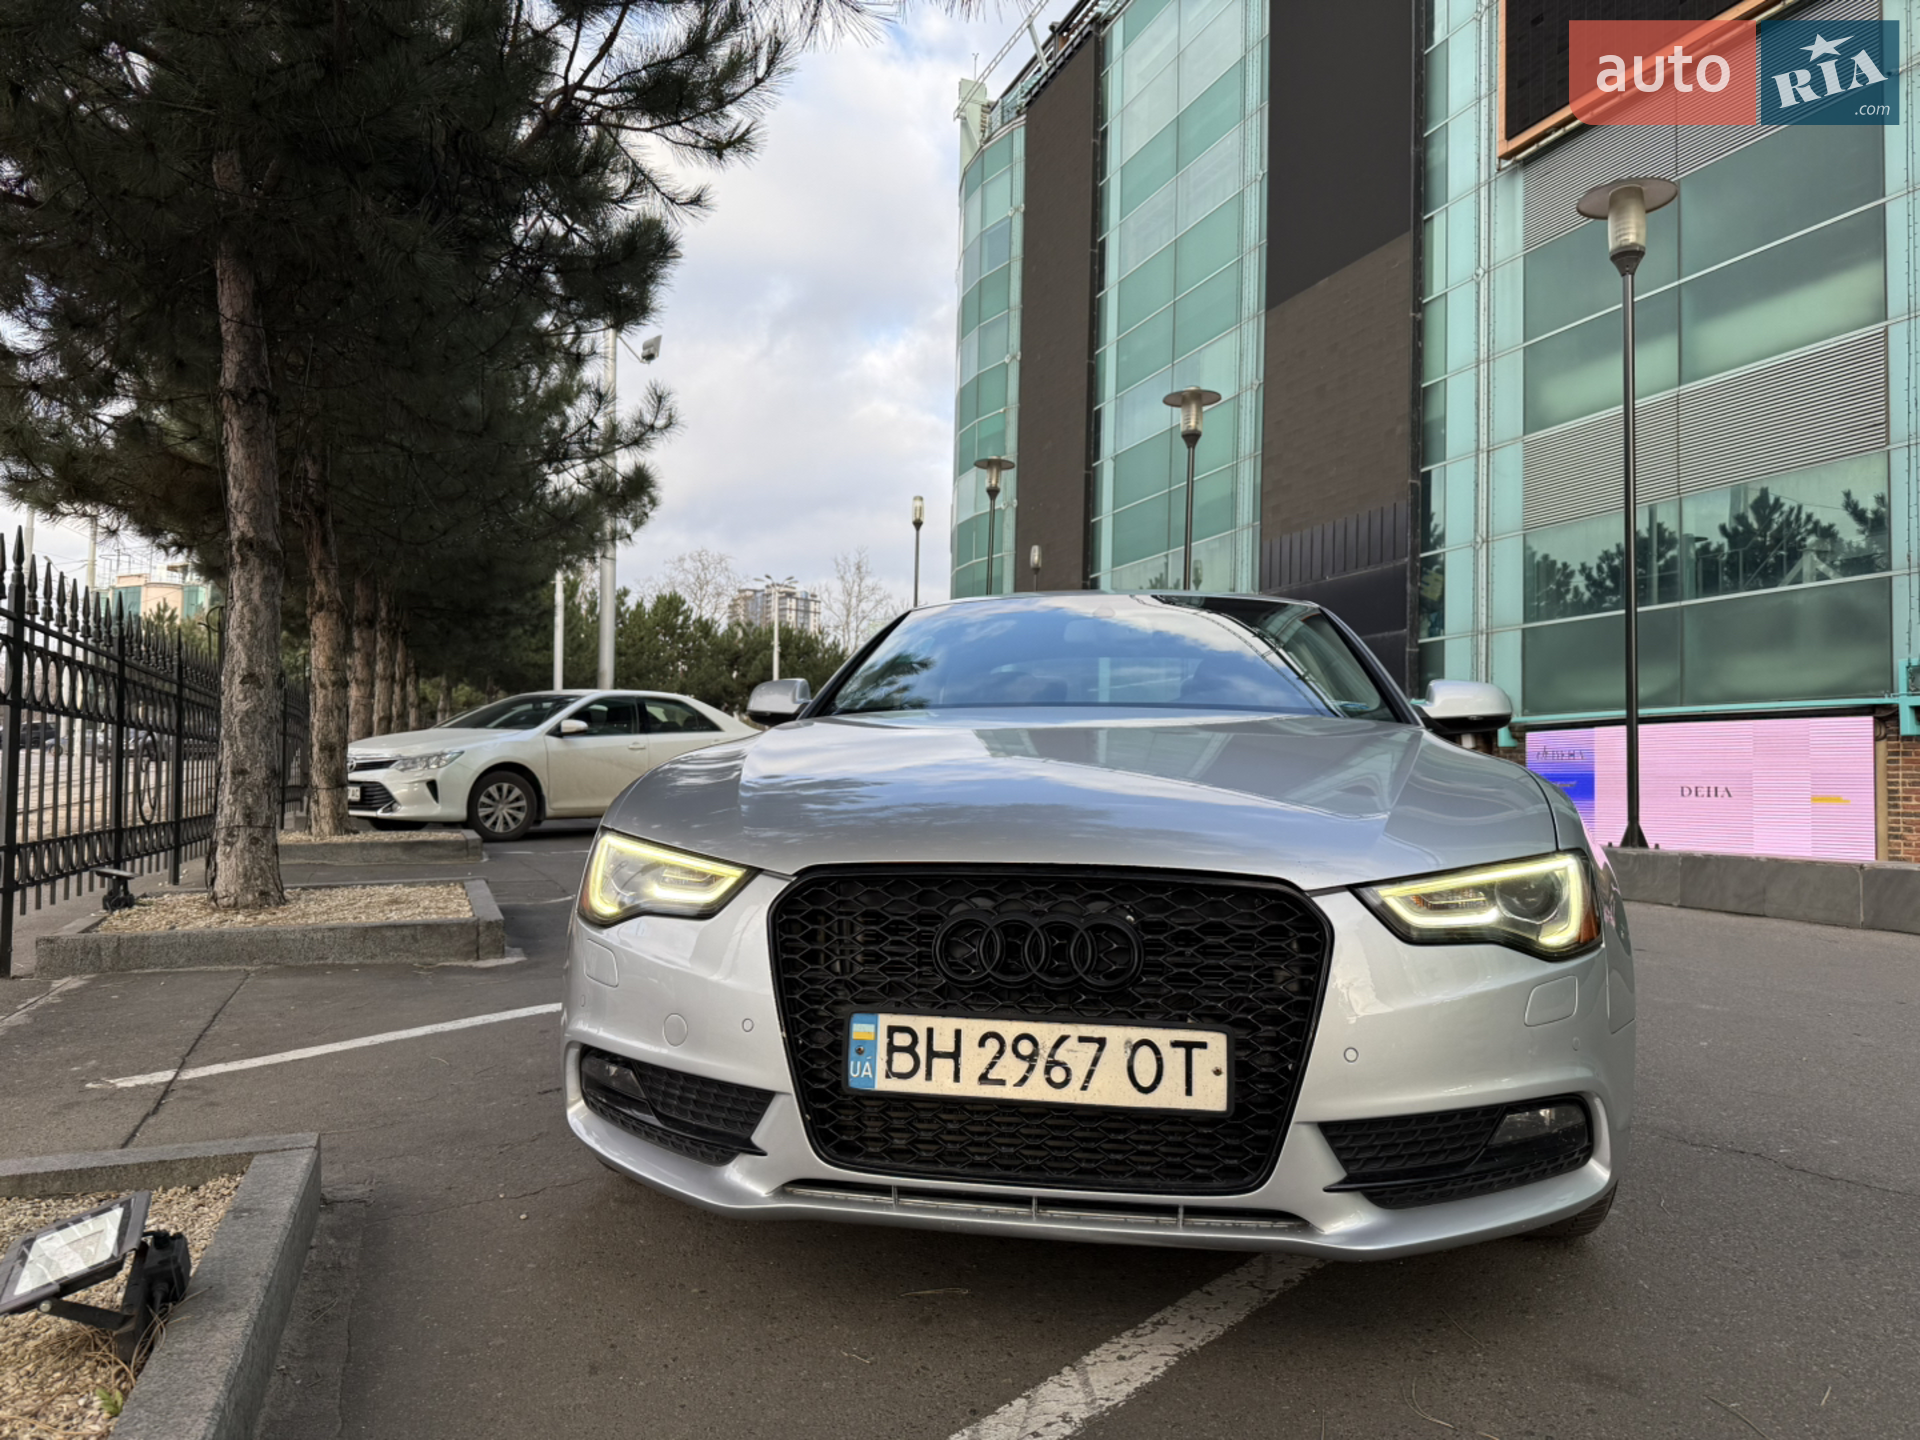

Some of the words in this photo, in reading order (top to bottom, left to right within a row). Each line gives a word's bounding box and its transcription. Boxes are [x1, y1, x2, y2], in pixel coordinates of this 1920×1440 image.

[850, 1060, 873, 1078] UA
[885, 1025, 962, 1083] BH
[977, 1031, 1107, 1091] 2967
[1127, 1038, 1208, 1097] OT
